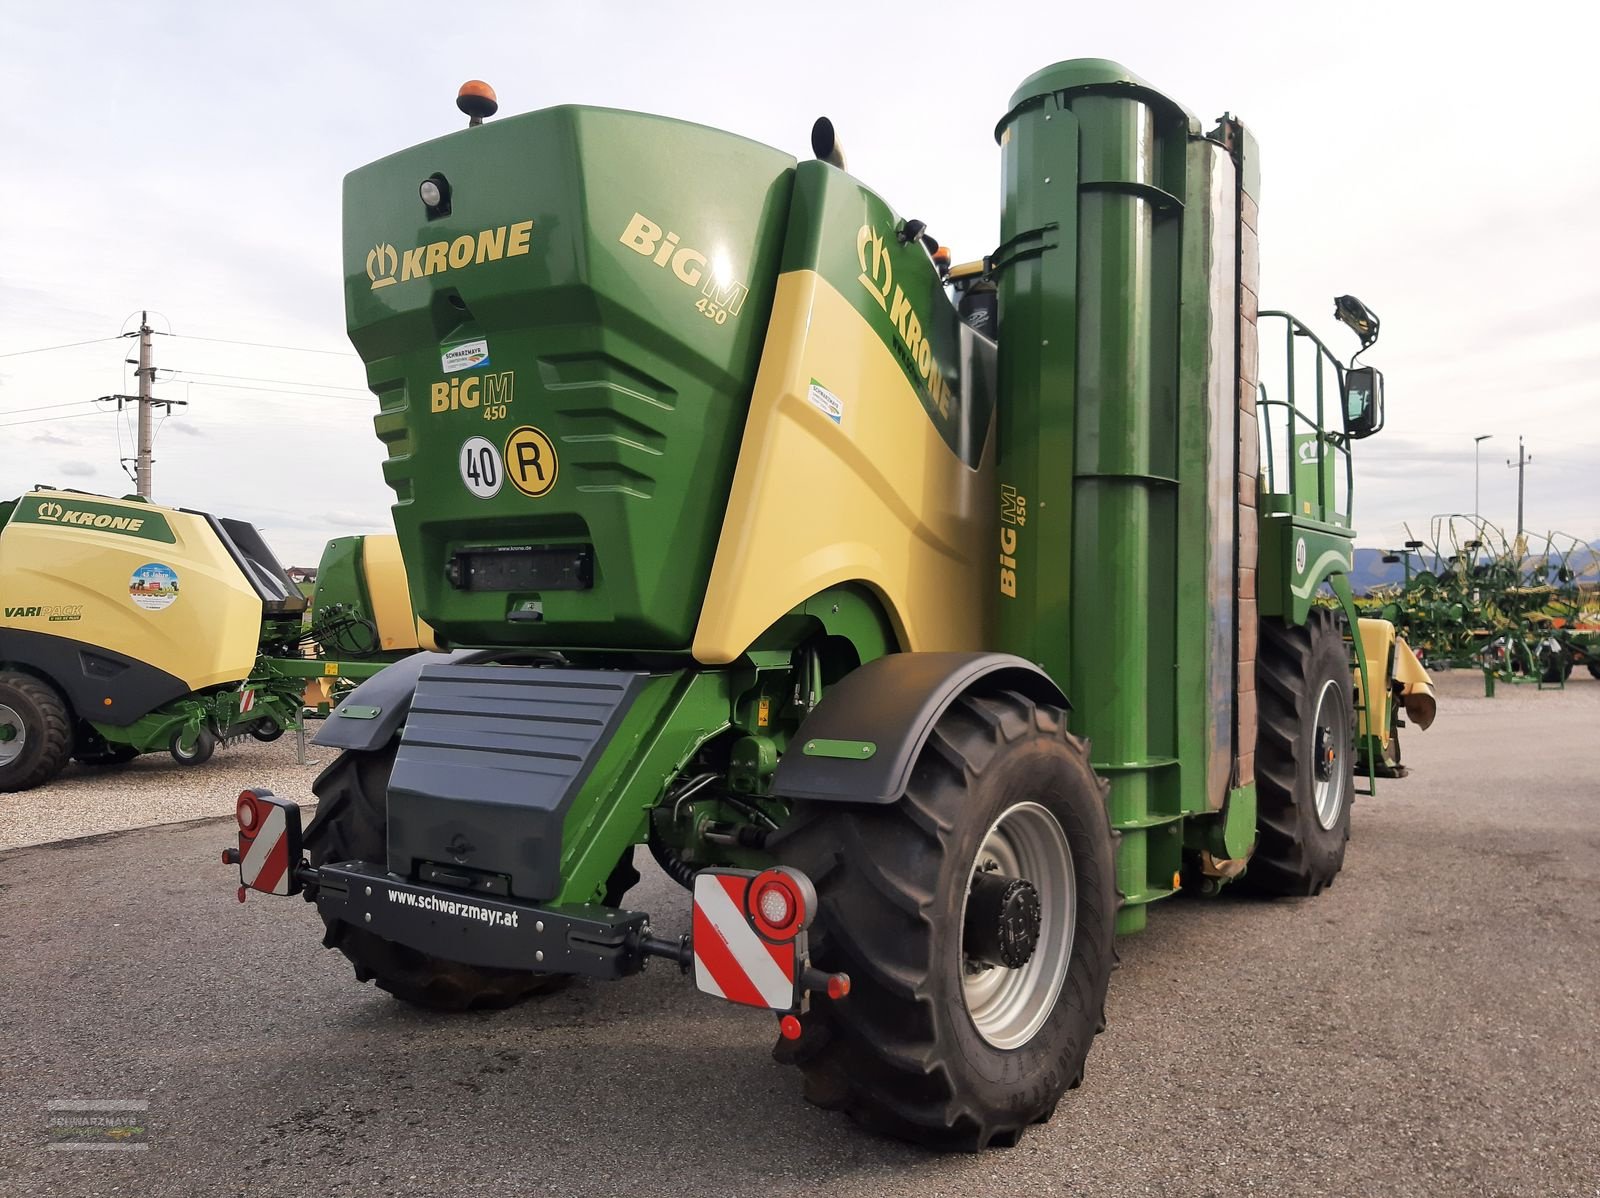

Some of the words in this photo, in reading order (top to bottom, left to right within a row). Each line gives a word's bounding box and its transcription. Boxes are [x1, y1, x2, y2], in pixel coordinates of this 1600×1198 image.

[401, 220, 533, 282] KRONE
[619, 212, 708, 287] BiG
[702, 264, 749, 317] M
[695, 298, 728, 325] 450
[446, 347, 481, 360] SCHWARZMAYR
[889, 283, 952, 421] KRONE
[432, 376, 480, 413] BiG
[483, 371, 514, 406] M
[483, 405, 507, 420] 450
[467, 447, 496, 487] 40
[516, 442, 545, 481] R
[61, 510, 144, 531] KRONE
[1000, 484, 1016, 525] M
[1016, 496, 1026, 526] 450
[1000, 527, 1016, 598] BiG
[388, 889, 518, 928] www.schwarzmayr.at
